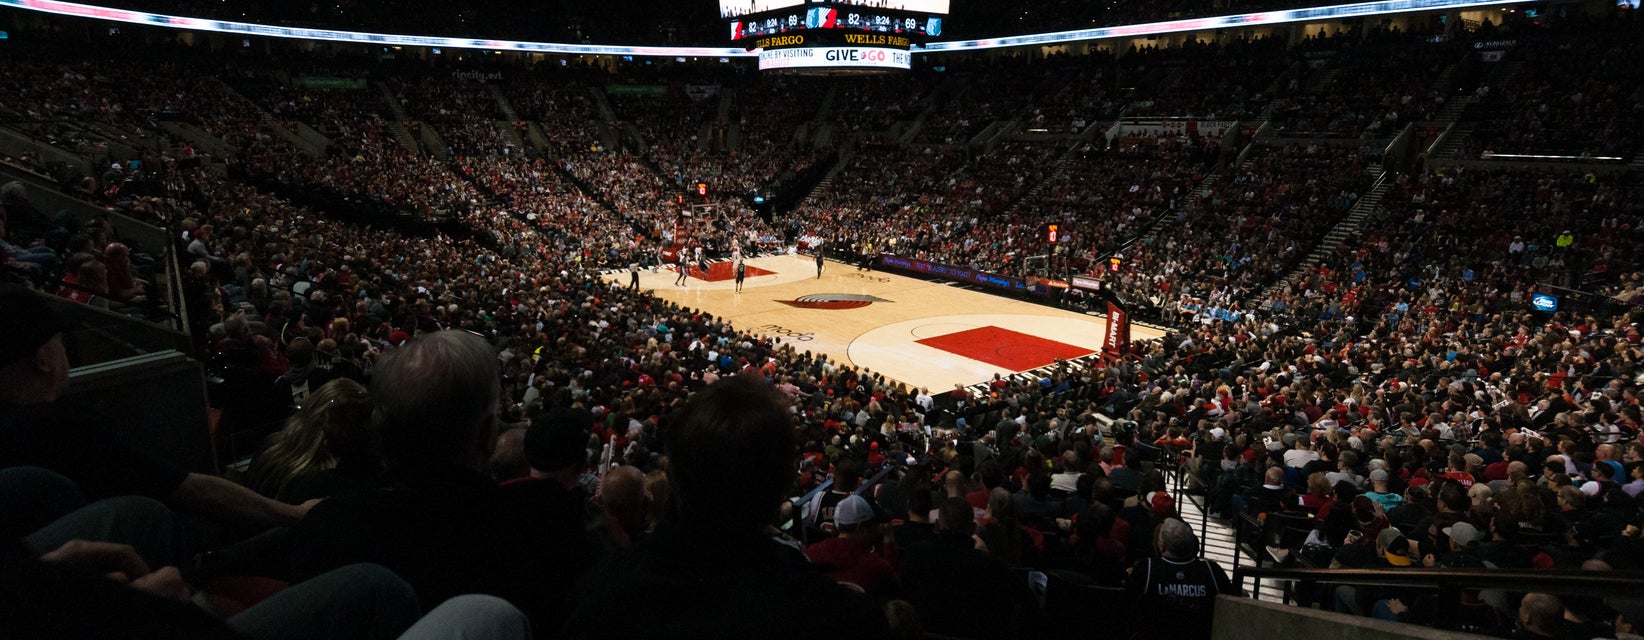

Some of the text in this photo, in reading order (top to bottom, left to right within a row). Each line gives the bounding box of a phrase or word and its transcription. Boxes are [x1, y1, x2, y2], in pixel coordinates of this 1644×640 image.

[748, 21, 757, 33] 82
[788, 14, 797, 26] 69
[848, 13, 859, 25] 82
[905, 18, 916, 29] 69
[771, 35, 804, 47] FARGO
[845, 34, 910, 46] WELLS FARGO
[774, 50, 782, 59] BY
[784, 49, 814, 58] VISITING
[826, 49, 885, 62] GIVE GO
[893, 52, 903, 64] THE
